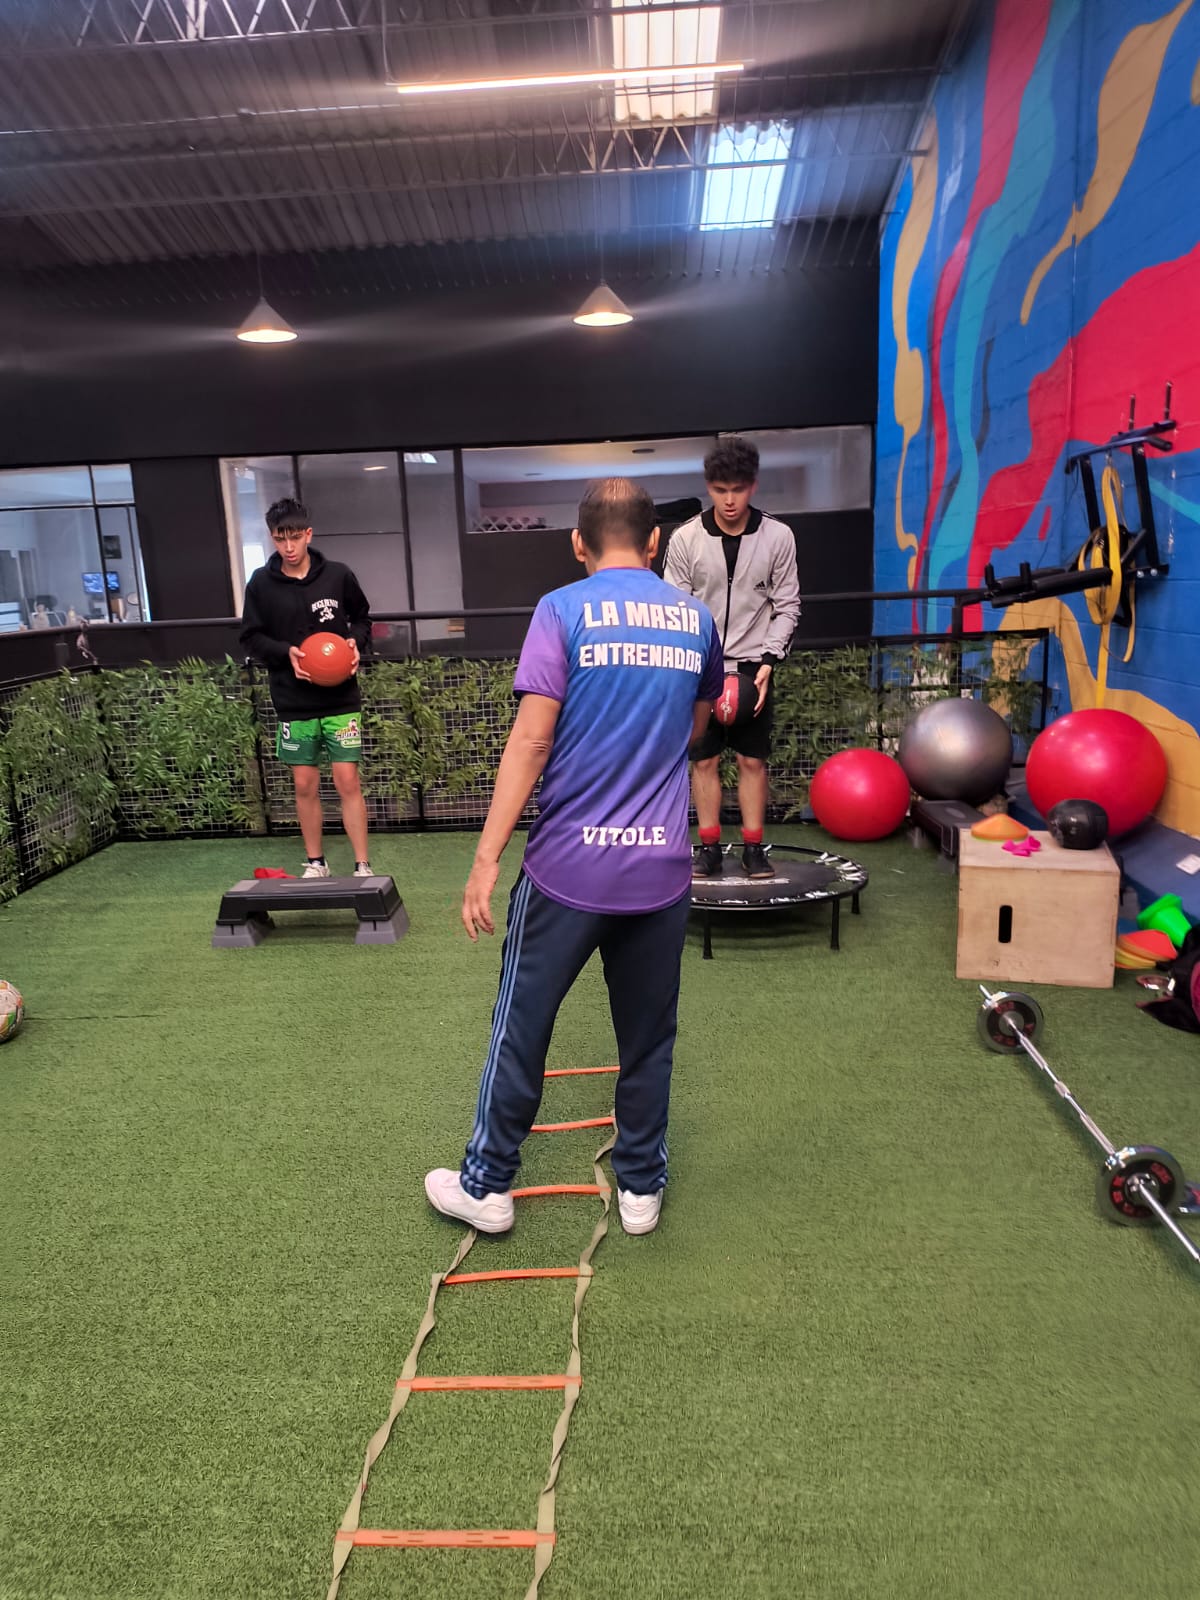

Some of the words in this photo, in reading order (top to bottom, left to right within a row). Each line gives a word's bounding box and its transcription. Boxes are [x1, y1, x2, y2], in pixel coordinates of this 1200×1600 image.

[583, 601, 620, 628] LA
[624, 601, 700, 635] MASÍA
[579, 642, 702, 674] ENTRENADOR
[282, 722, 291, 740] 5
[582, 826, 667, 846] VITOLE
